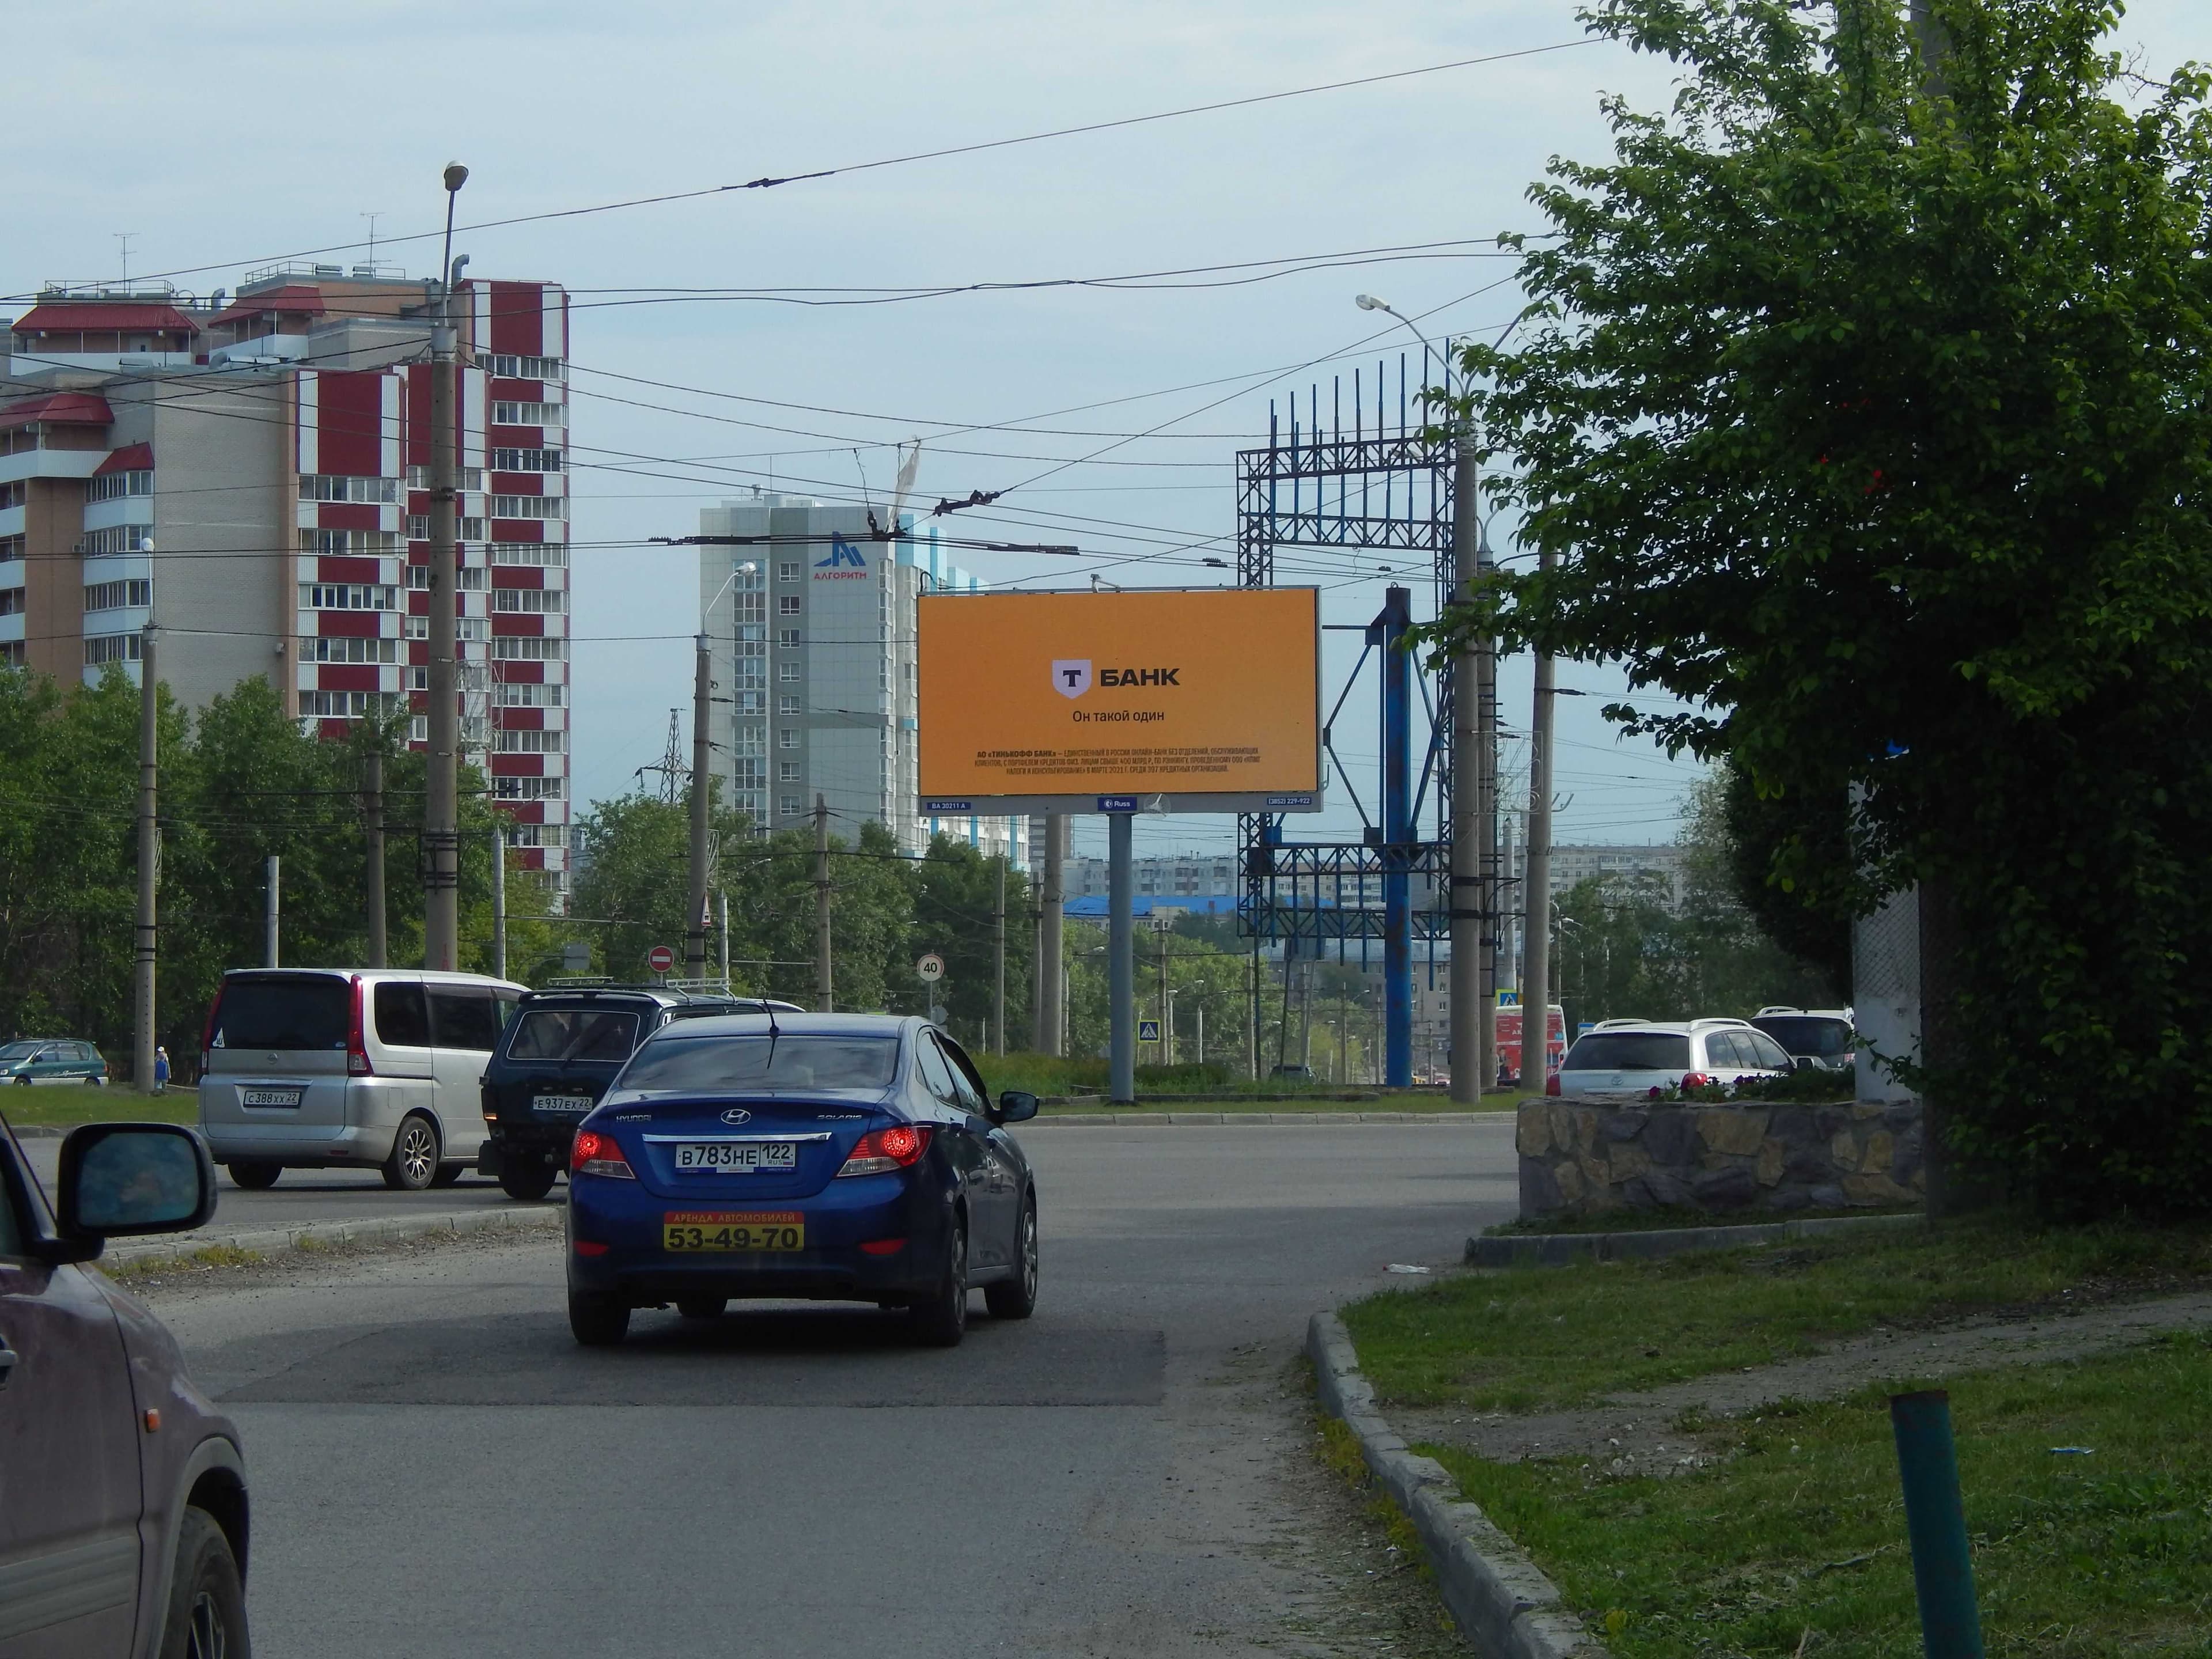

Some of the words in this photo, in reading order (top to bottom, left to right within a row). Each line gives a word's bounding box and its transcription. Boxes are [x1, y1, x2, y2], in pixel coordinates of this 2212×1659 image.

[814, 571, 866, 579] АЛГОРИТМ
[1063, 670, 1081, 687] Т
[1100, 668, 1180, 687] БАНК
[1073, 711, 1090, 722] Он
[1093, 710, 1130, 721] такой
[1133, 711, 1164, 722] один
[924, 963, 937, 973] 40
[762, 1145, 790, 1159] 122
[674, 1214, 713, 1222] АРЕНДА
[718, 1212, 795, 1222] АВТОМОБИЛЕЙ
[668, 1228, 798, 1249] 53-49-70
